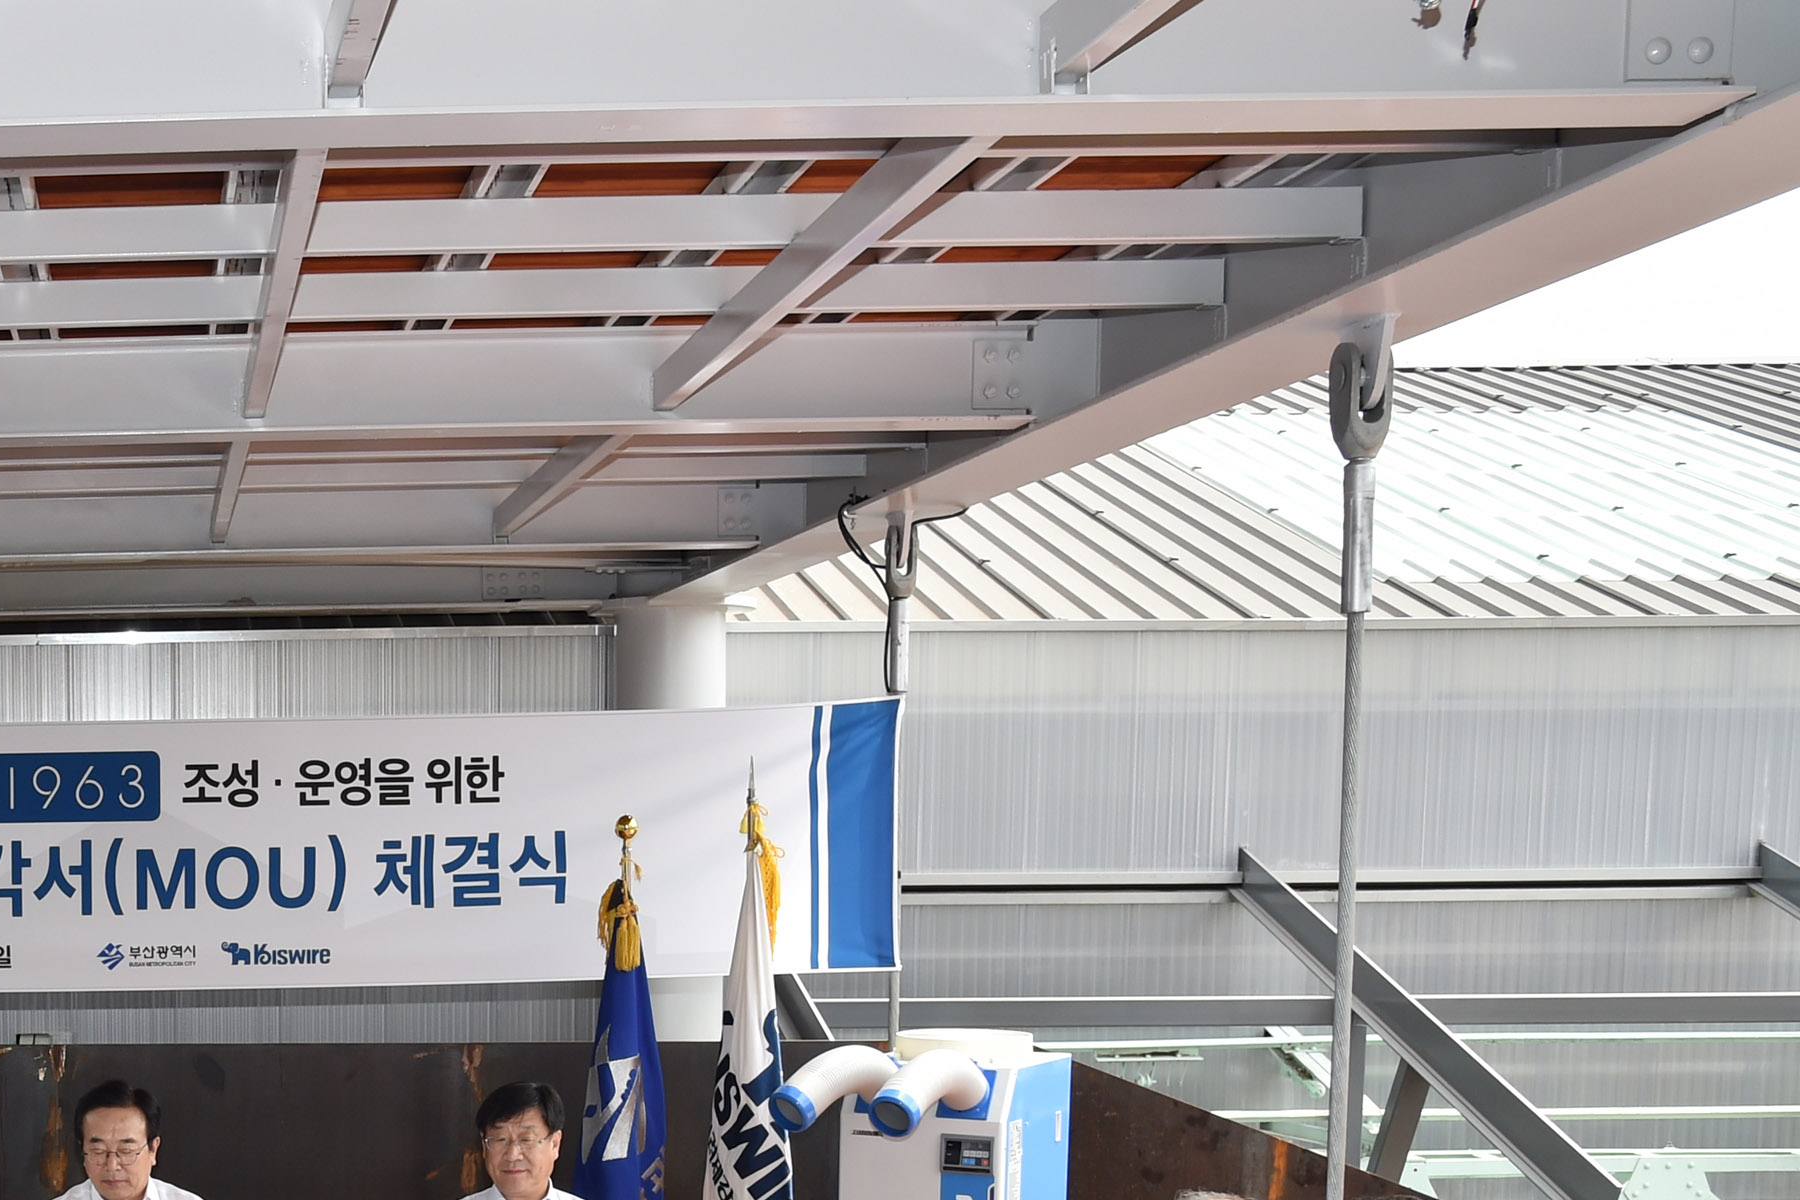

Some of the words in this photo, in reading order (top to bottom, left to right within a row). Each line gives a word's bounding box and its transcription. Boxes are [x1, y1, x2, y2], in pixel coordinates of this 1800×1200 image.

[424, 755, 505, 805] 위한
[374, 830, 567, 908] 체결식
[128, 944, 197, 959] 부산광역시
